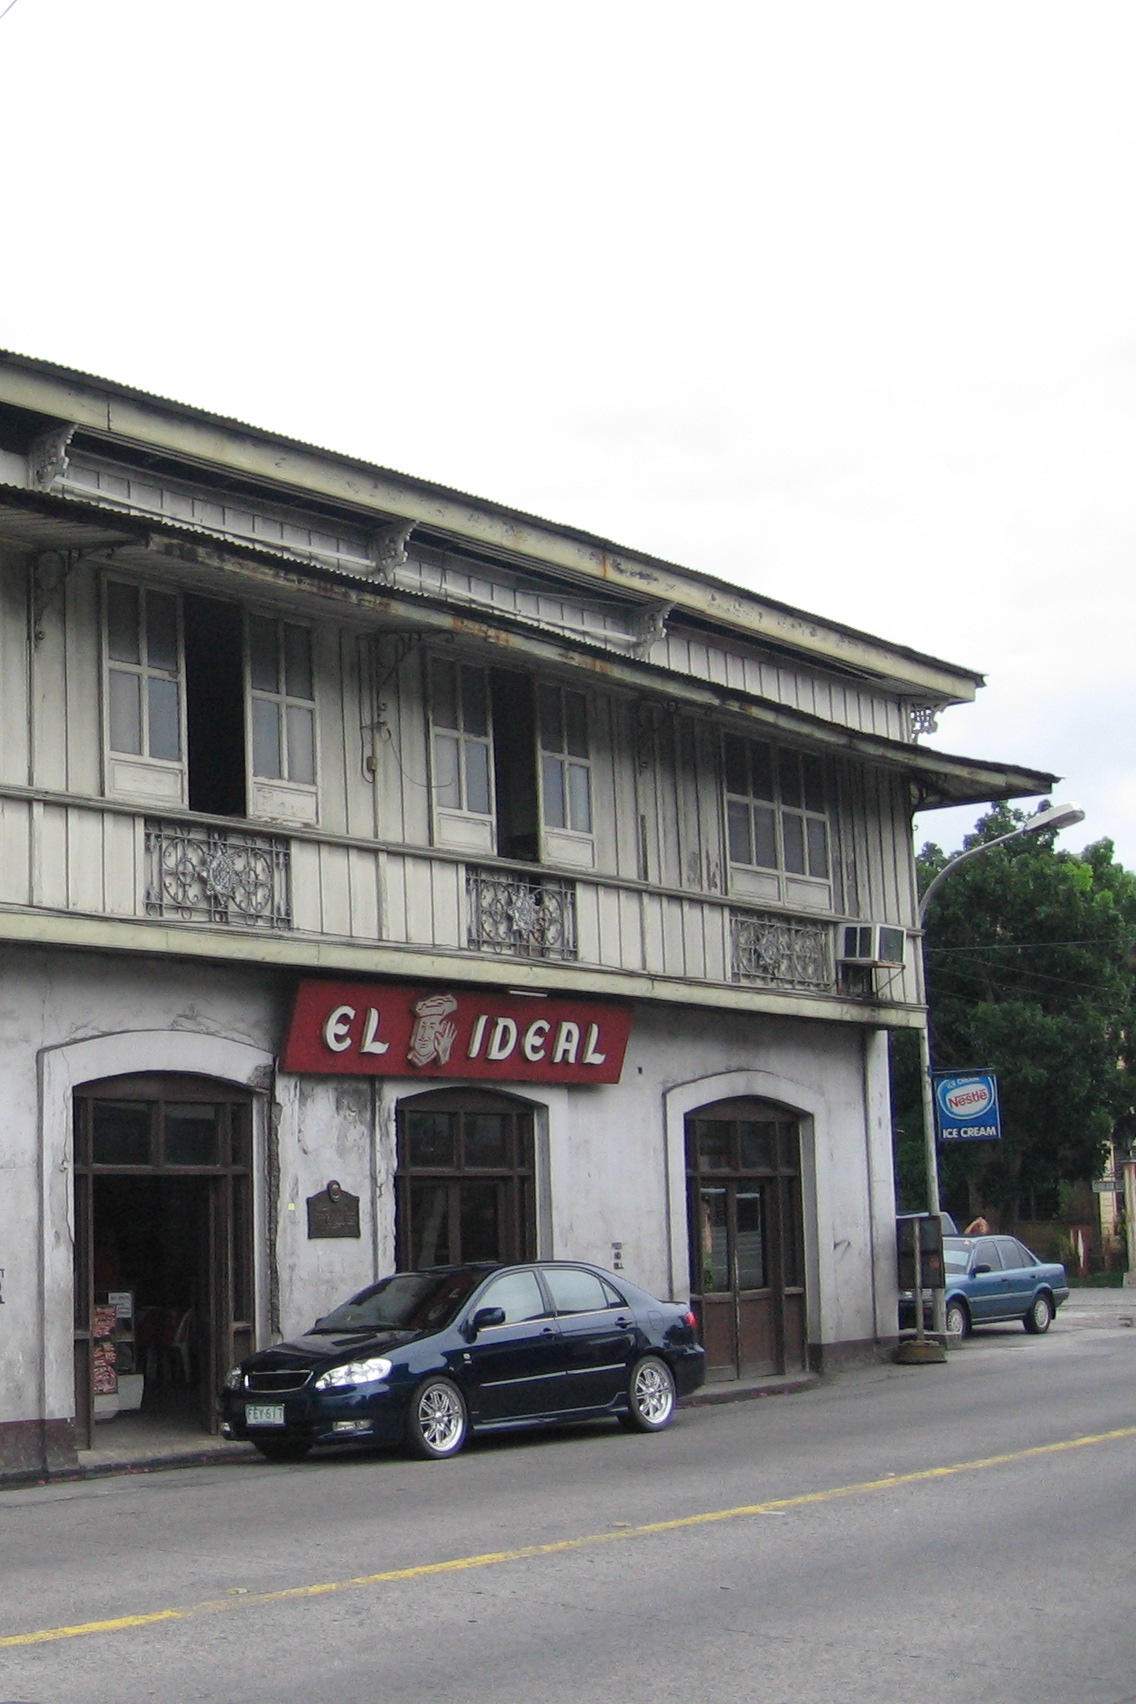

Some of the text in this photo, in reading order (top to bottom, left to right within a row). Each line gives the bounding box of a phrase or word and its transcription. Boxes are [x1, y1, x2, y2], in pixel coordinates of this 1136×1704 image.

[323, 1004, 606, 1065] EL IDEAL
[943, 1126, 996, 1138] ICE CREAM
